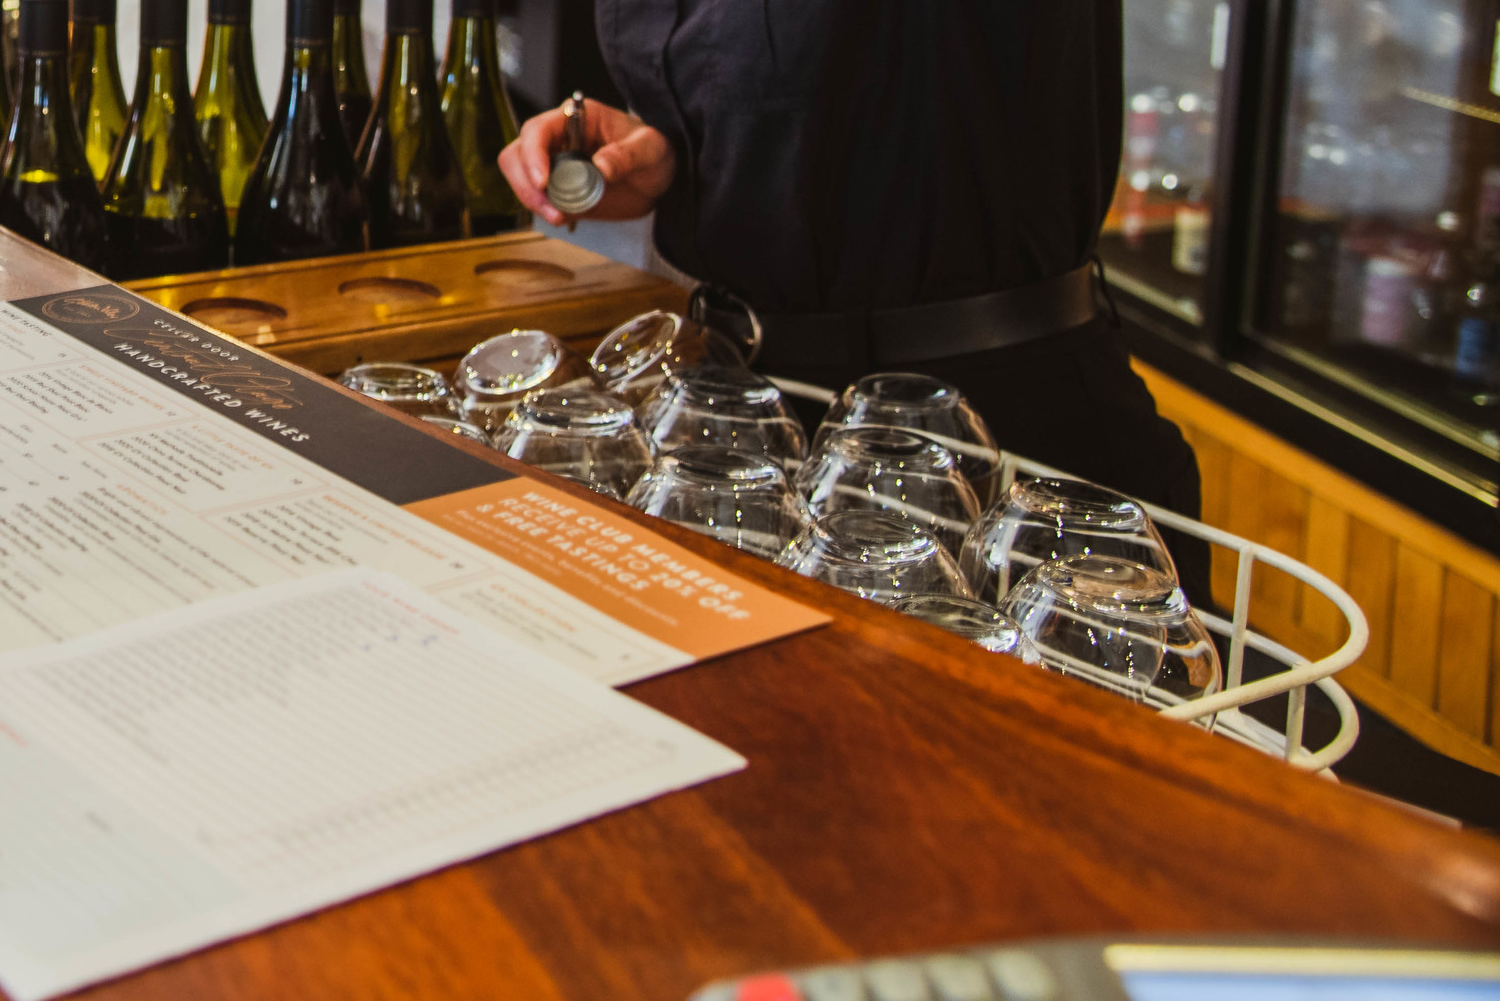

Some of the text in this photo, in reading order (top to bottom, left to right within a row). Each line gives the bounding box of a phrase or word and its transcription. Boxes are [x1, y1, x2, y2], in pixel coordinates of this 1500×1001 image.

[1, 309, 52, 336] WINE TASTING
[154, 320, 239, 361] CELLAR DOOR
[114, 343, 242, 407] HANDCRAFTED
[245, 409, 310, 442] WINES
[492, 510, 548, 537] FREE
[547, 535, 649, 591] TASTINGS
[499, 497, 751, 620] RECEIVE UP TO 20% OFF
[522, 491, 578, 518] WINE
[576, 515, 634, 544] CLUB
[630, 542, 744, 601] MEMBERS
